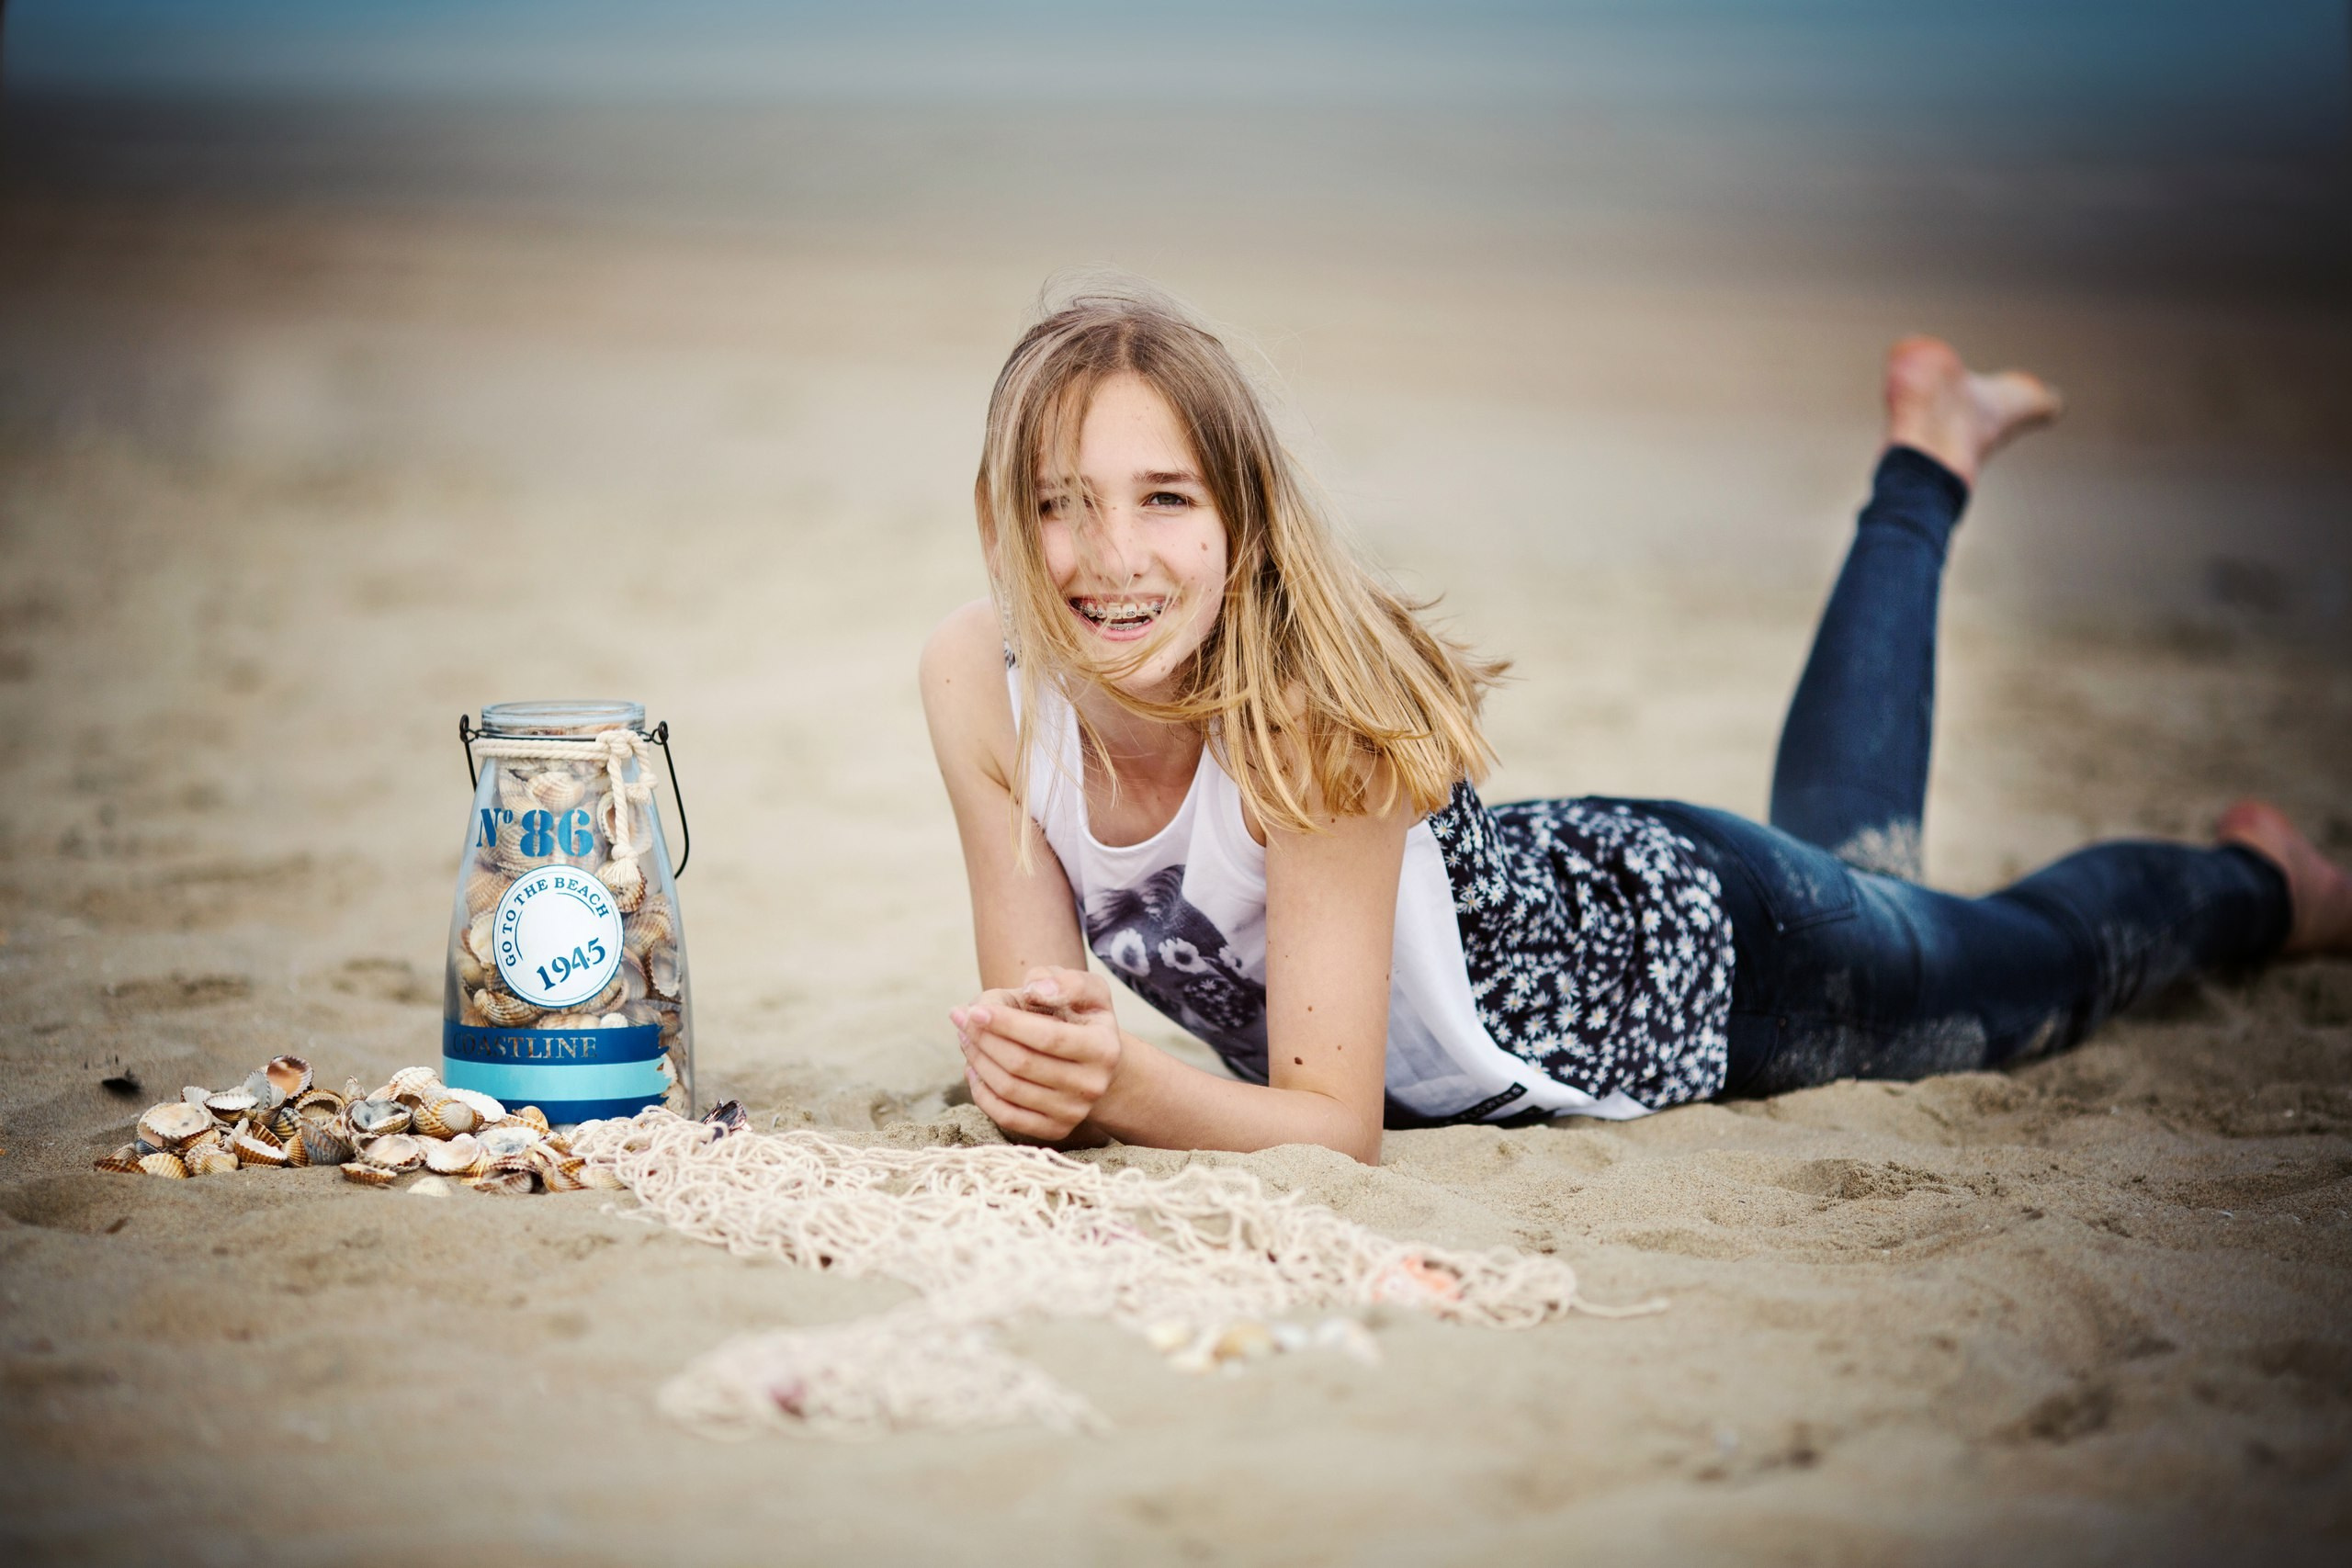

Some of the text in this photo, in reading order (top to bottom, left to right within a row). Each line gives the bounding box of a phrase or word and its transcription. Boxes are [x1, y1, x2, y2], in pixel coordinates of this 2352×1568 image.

[519, 808, 594, 858] 86
[502, 876, 609, 967] GO TO THE BEACH
[536, 937, 606, 991] 1945
[453, 1032, 597, 1059] COASTLINE
